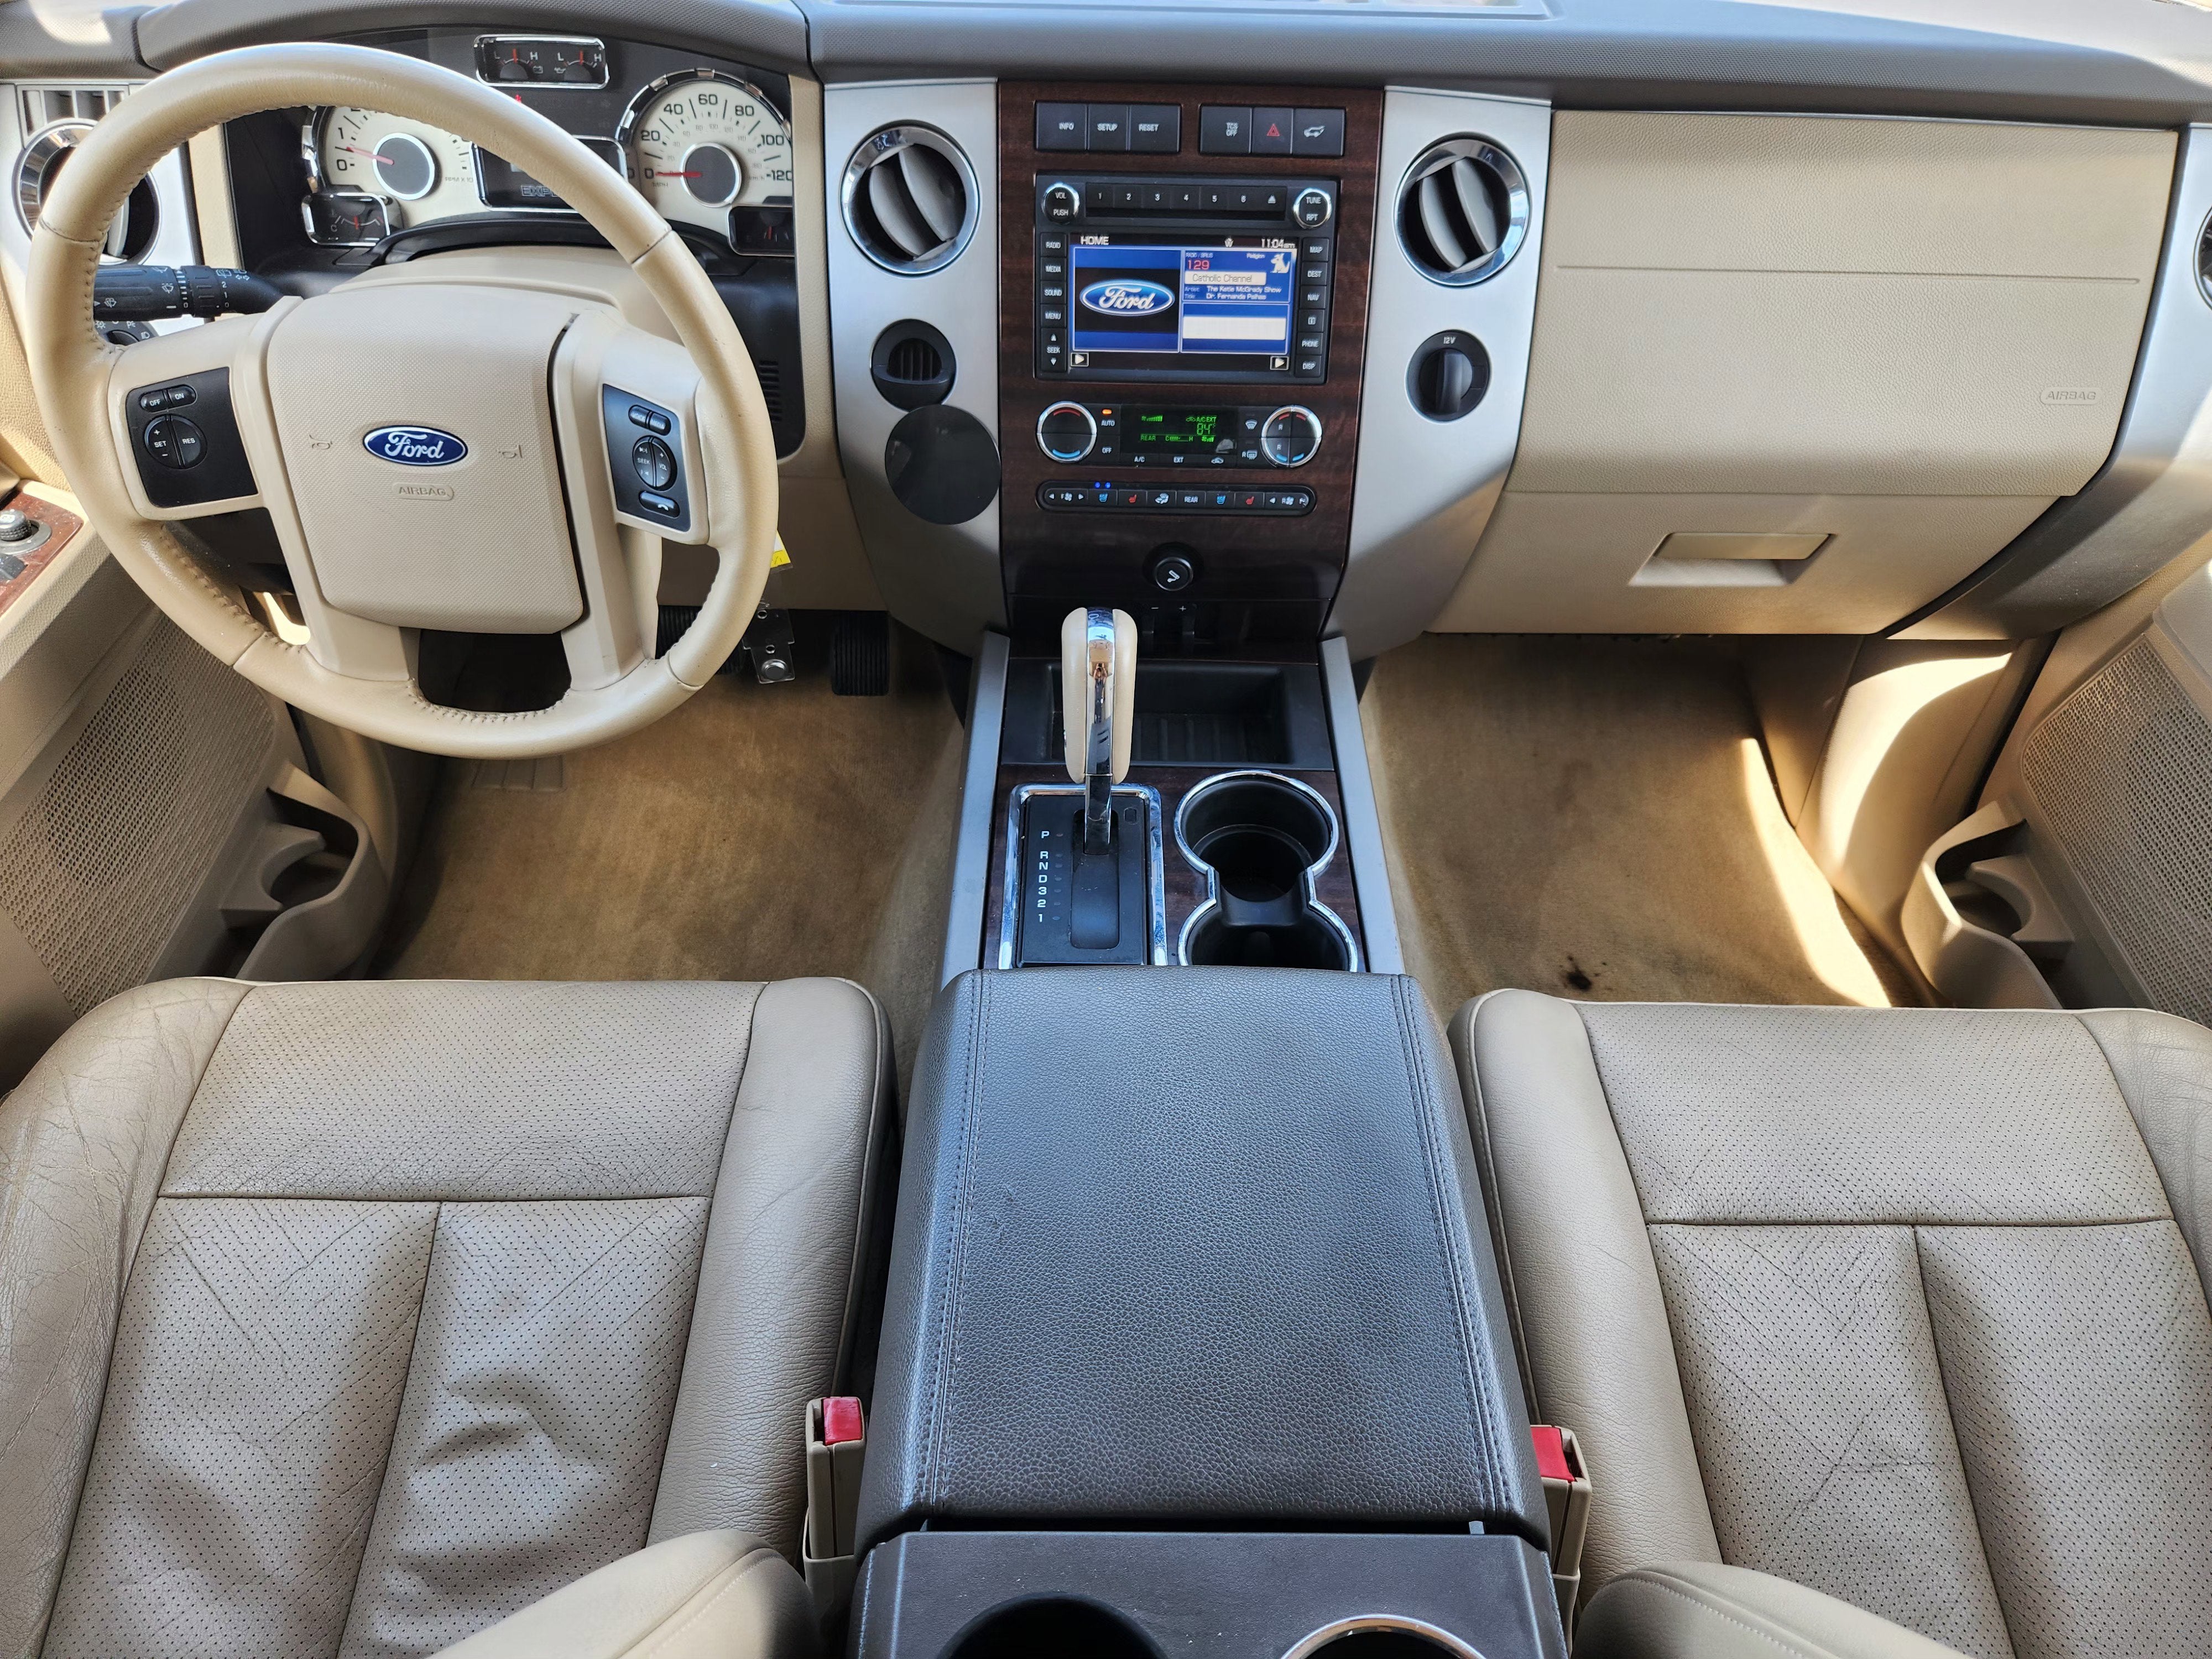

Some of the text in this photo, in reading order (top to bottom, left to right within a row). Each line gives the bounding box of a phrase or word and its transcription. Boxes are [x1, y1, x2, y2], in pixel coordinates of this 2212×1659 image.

[530, 51, 538, 60] H
[557, 52, 564, 61] L
[594, 53, 602, 62] H
[698, 94, 718, 105] 60
[664, 103, 682, 115] 40
[735, 105, 754, 117] 80
[1058, 122, 1074, 131] INFO
[1097, 123, 1118, 132] SETUP
[1138, 123, 1159, 132] RESET
[338, 127, 343, 139] 1
[640, 131, 660, 141] 20
[1226, 129, 1238, 137] OFF
[761, 134, 784, 145] 100
[337, 159, 347, 171] 0
[645, 168, 654, 180] 0
[1080, 236, 1109, 245] HOME
[1188, 260, 1210, 270] 129
[1193, 273, 1252, 283] Catholic Channel
[1044, 288, 1062, 296] SOUND
[1099, 286, 1156, 310] Ford
[1045, 311, 1061, 320] MENU
[1302, 339, 1319, 347] PHONE
[1302, 362, 1316, 370] DISP
[2047, 390, 2096, 400] AIRBAG
[149, 399, 161, 407] OFF
[384, 431, 445, 460] Ford
[658, 462, 667, 471] VOL
[398, 486, 447, 496] AIRBAG
[1039, 875, 1047, 883] D
[1038, 887, 1047, 895] 3
[1037, 899, 1046, 907] 2
[1039, 914, 1042, 922] 1
